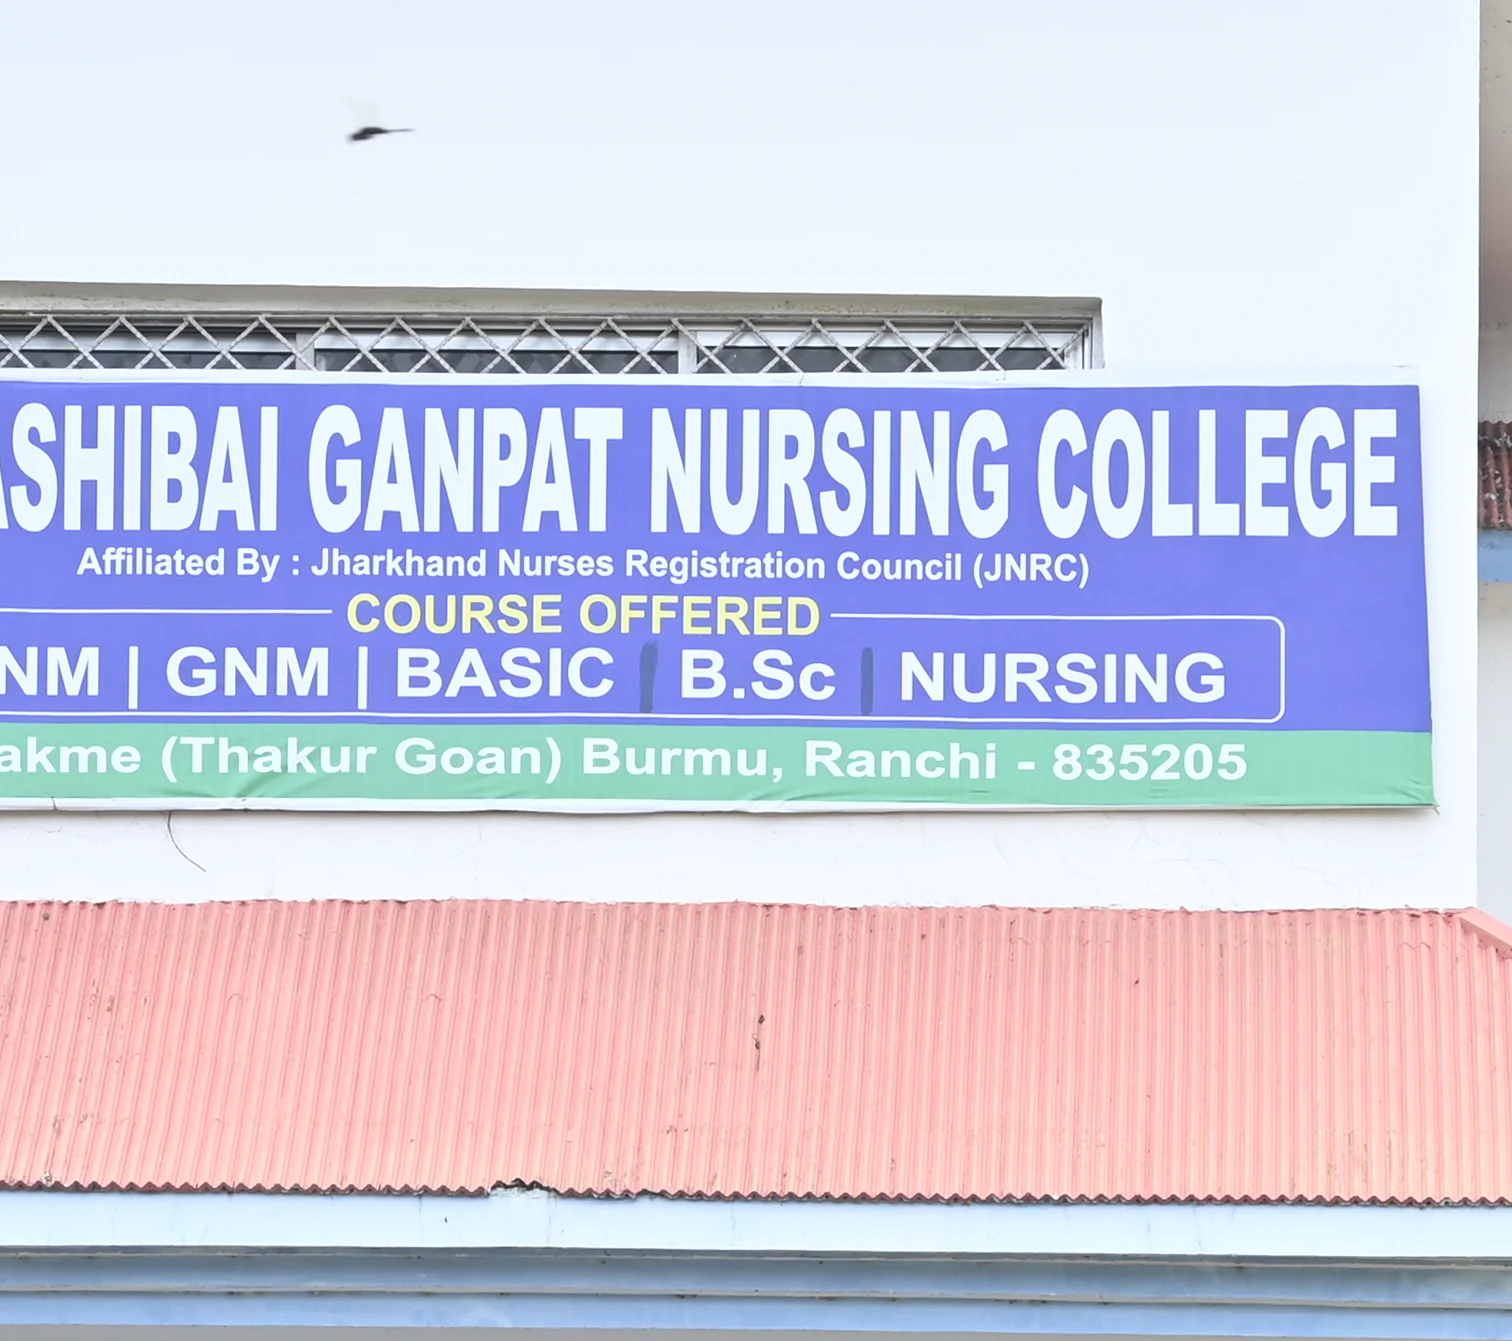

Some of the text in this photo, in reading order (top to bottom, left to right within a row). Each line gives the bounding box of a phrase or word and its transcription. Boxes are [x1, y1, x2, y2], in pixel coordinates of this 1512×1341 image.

[308, 404, 624, 534] GANPAT
[650, 407, 1009, 539] NURSING
[1037, 406, 1398, 539] COLLEGE
[76, 546, 225, 576] Affiliated
[236, 547, 281, 583] By
[310, 547, 487, 577] Jharkhand
[498, 548, 614, 577] Nurses
[625, 549, 825, 585] Registration
[836, 551, 962, 581] Council
[973, 553, 1090, 589] (JNRC)
[347, 592, 820, 636] COURSE OFFERED
[166, 646, 329, 697] GNM
[397, 647, 614, 698] BASIC
[681, 648, 836, 701] B.Sc
[901, 651, 1225, 704] NURSING
[161, 735, 378, 784] (Thakur
[395, 736, 562, 785] Goan)
[583, 737, 783, 783] Burmu,
[805, 739, 996, 779] Ranchi
[1052, 743, 1247, 781] 835205
